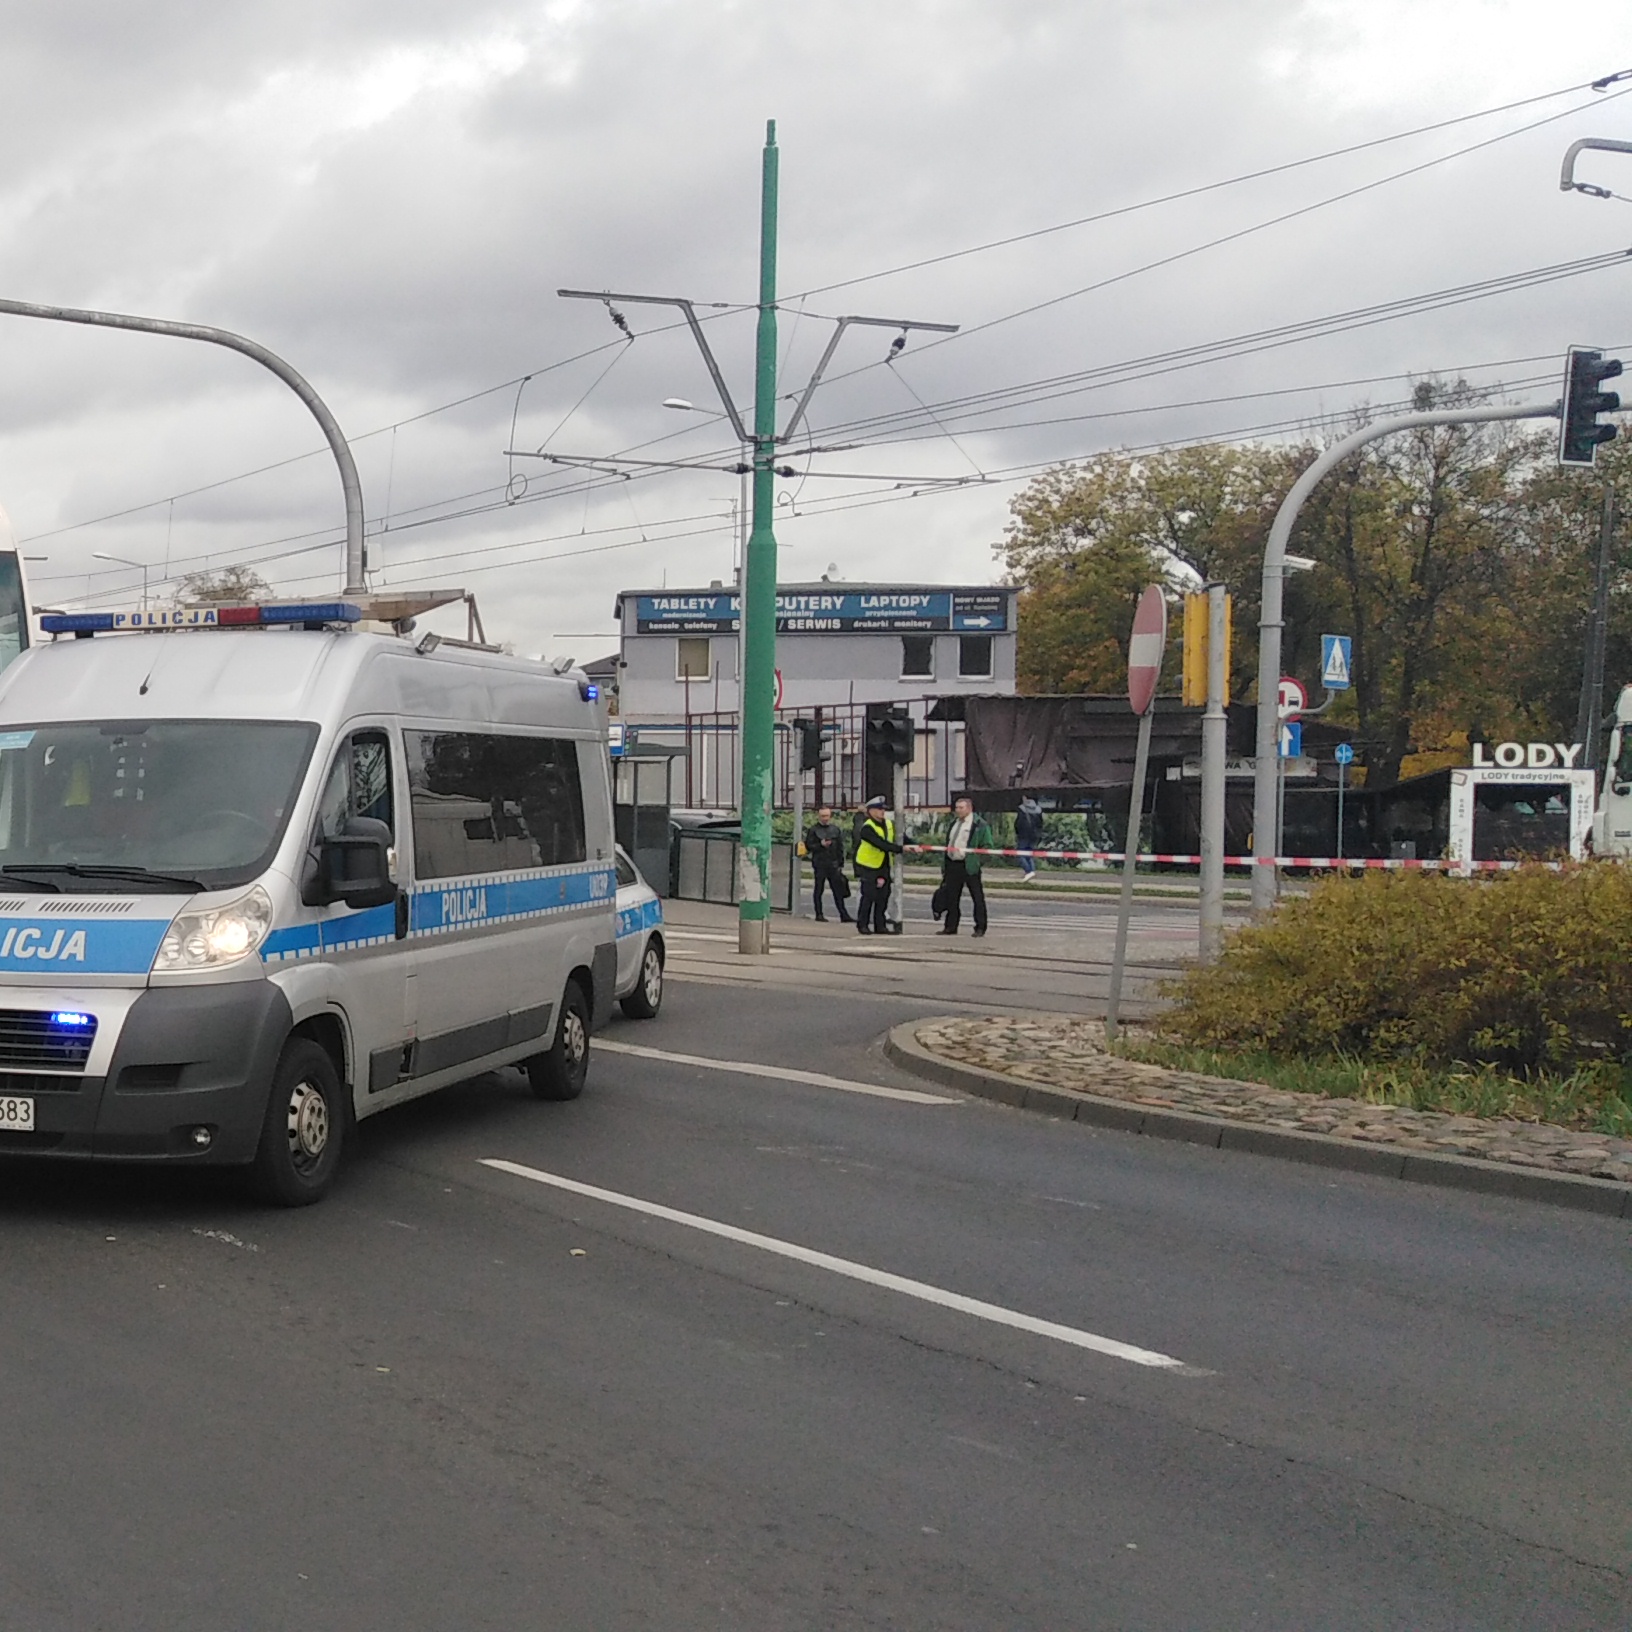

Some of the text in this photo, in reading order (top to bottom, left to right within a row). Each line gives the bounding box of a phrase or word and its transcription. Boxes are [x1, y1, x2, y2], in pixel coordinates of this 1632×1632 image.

[651, 595, 931, 610] TABLETY KPUTERY LAPTOPY
[115, 610, 216, 626] POLICJA
[648, 622, 681, 630] konsole
[684, 622, 718, 630] telefony
[787, 618, 842, 630] SERWIS
[893, 620, 932, 628] monitory
[1472, 742, 1583, 768] LODY
[1481, 772, 1566, 781] LODY tradycyjne
[441, 888, 487, 924] POLICJA
